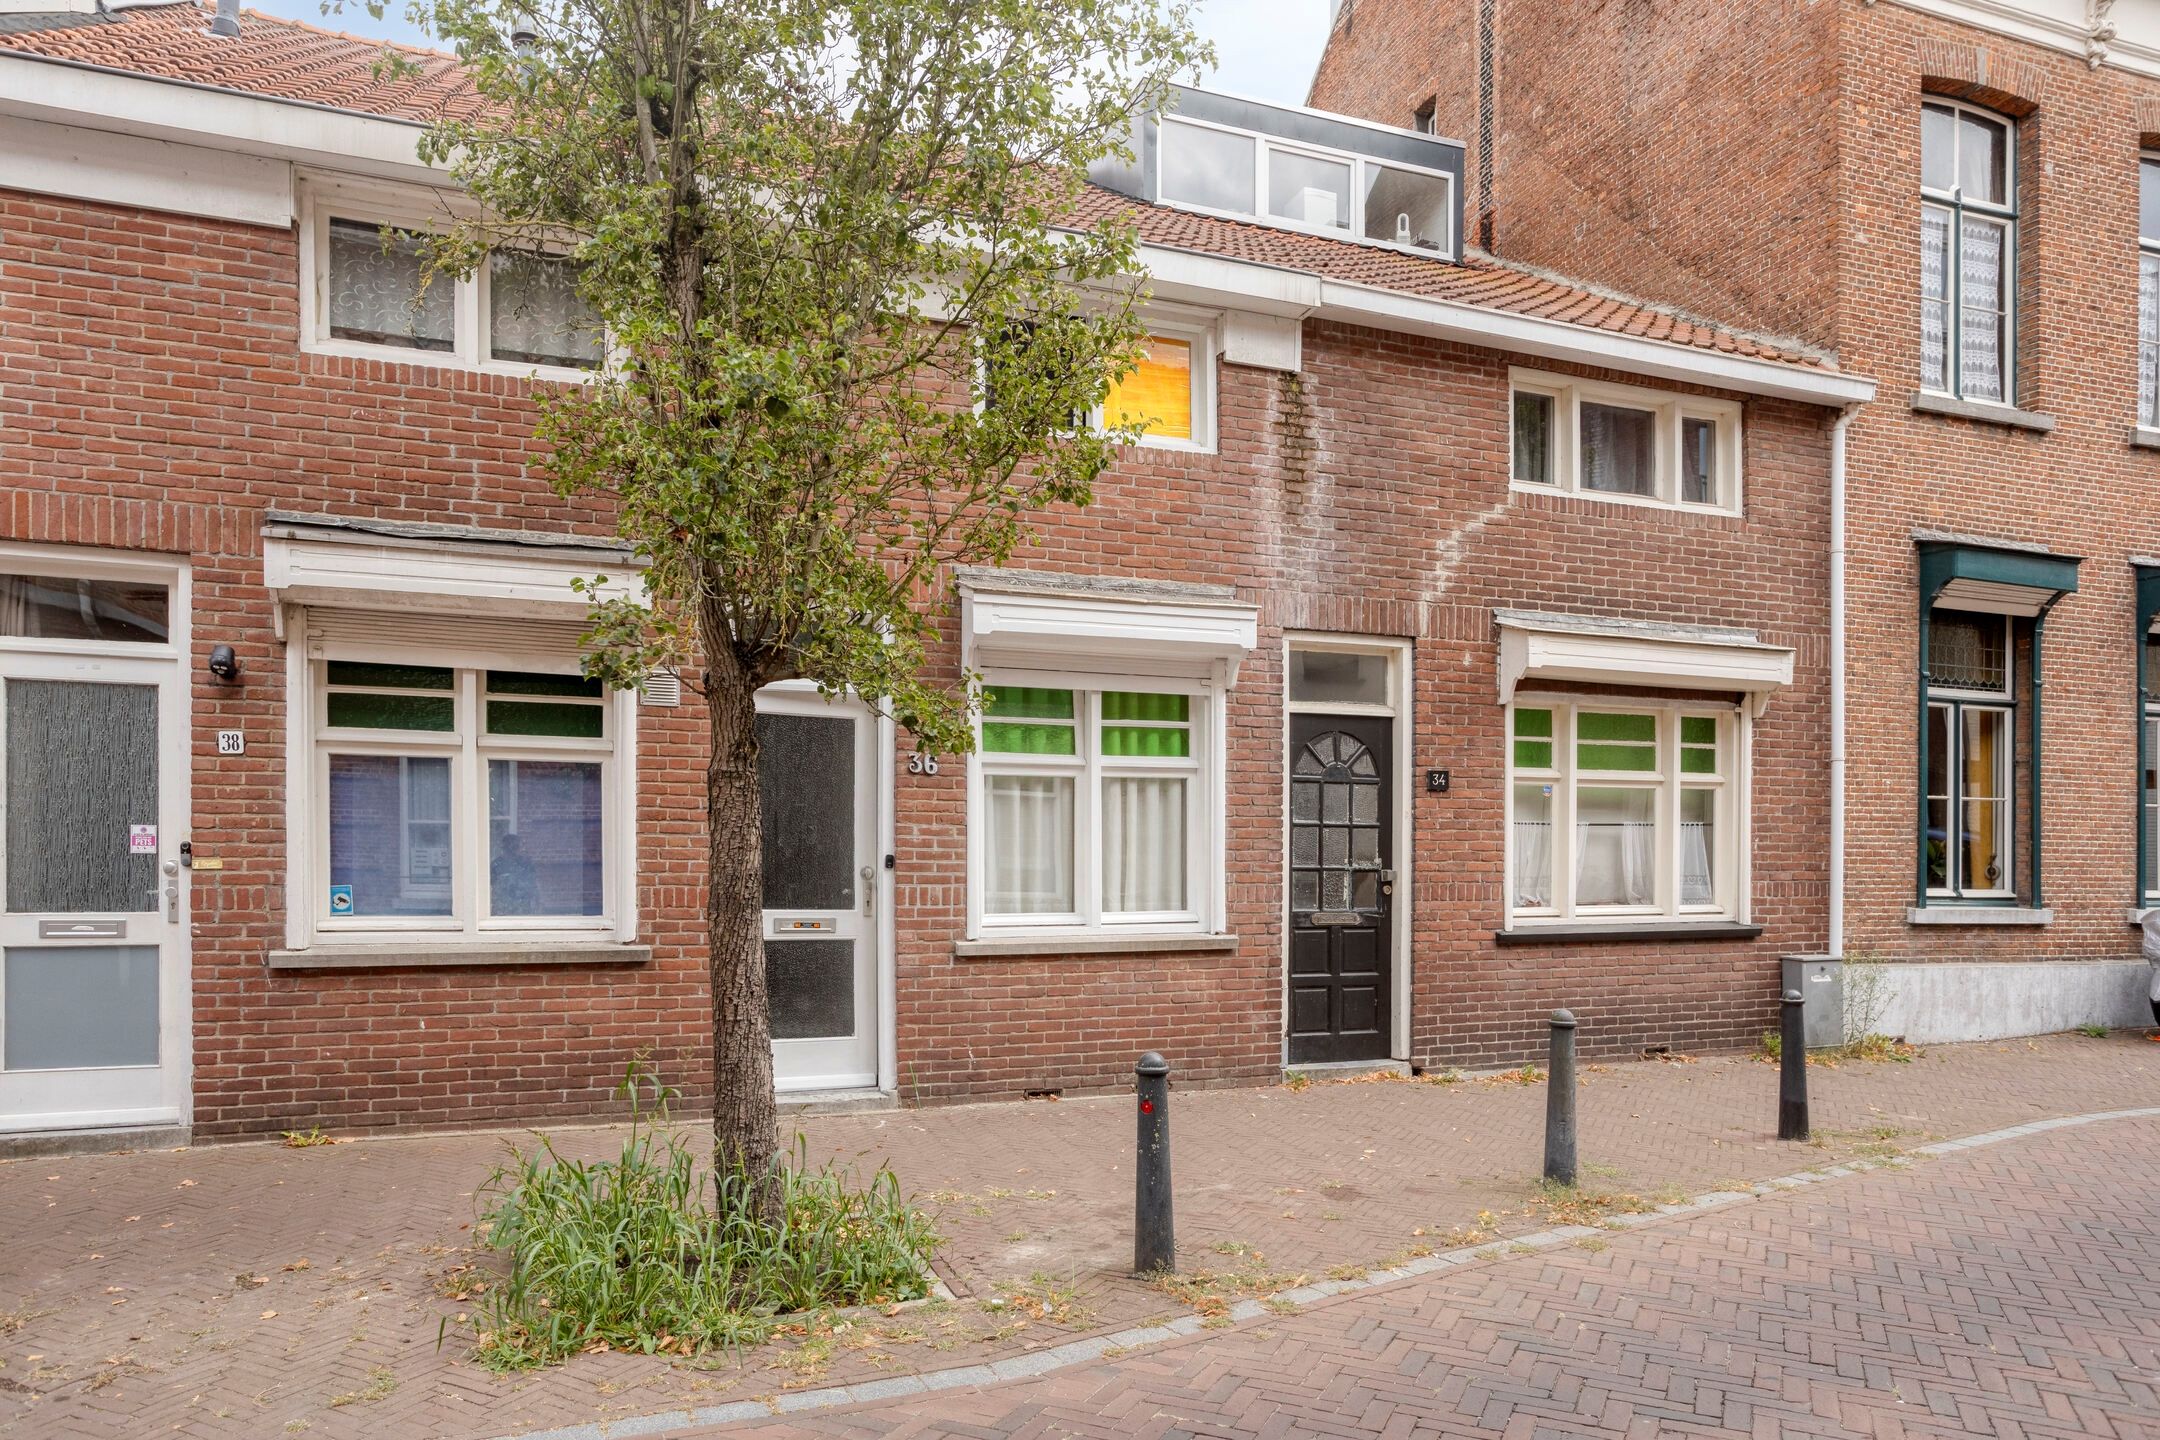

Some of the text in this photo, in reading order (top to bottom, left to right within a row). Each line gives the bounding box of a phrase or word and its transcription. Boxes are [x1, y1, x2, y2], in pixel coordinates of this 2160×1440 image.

[221, 733, 240, 751] 38
[908, 751, 938, 775] 36
[1432, 773, 1446, 785] 34
[135, 838, 152, 846] PETS
